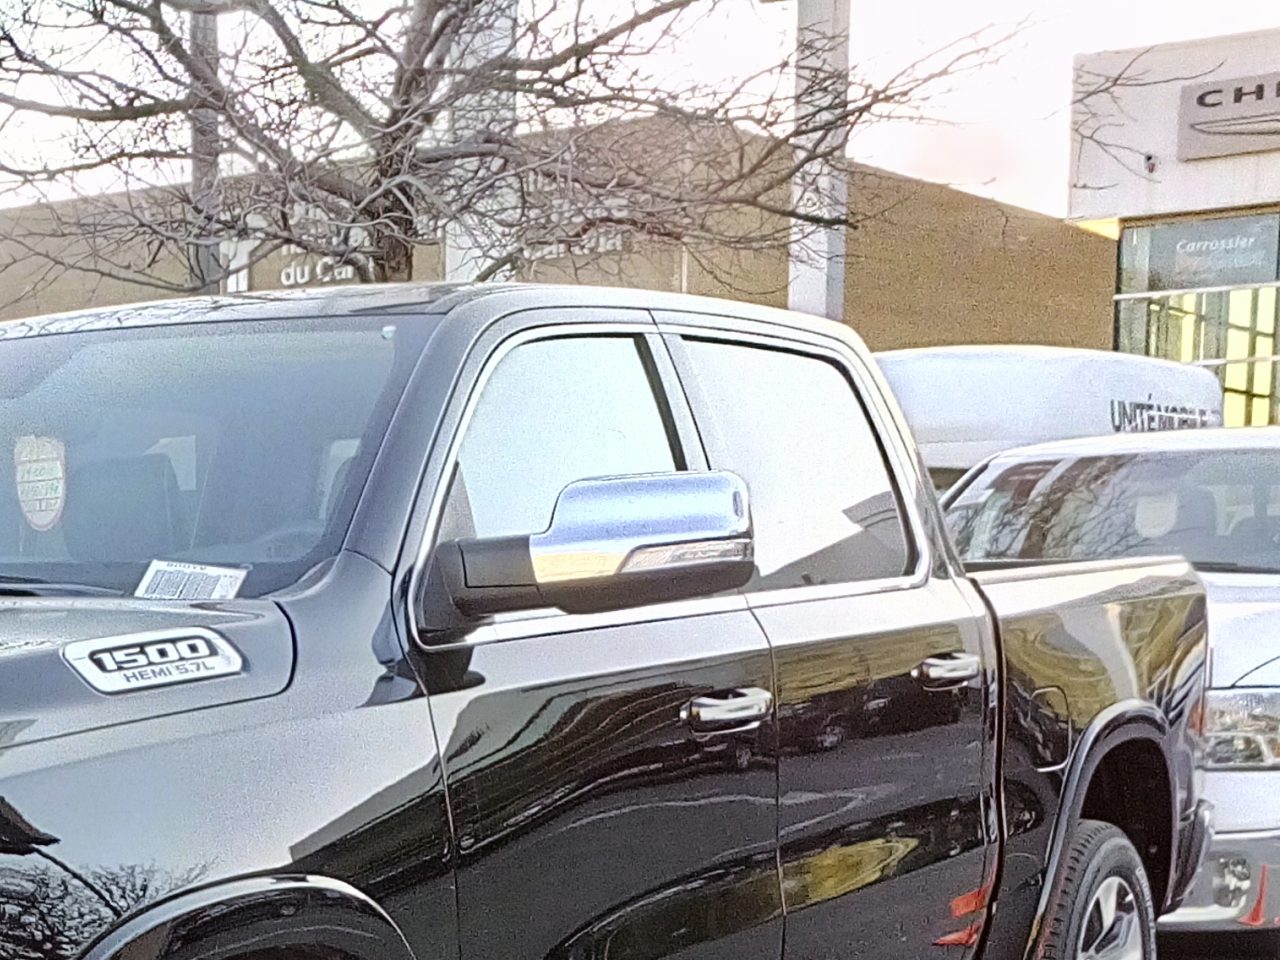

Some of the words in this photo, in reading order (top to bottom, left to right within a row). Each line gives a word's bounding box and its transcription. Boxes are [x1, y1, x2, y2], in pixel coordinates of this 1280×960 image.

[1195, 81, 1280, 108] CH
[280, 261, 310, 287] du
[92, 637, 211, 672] 1500
[123, 666, 173, 684] HEMI
[175, 660, 216, 676] 5.7L
